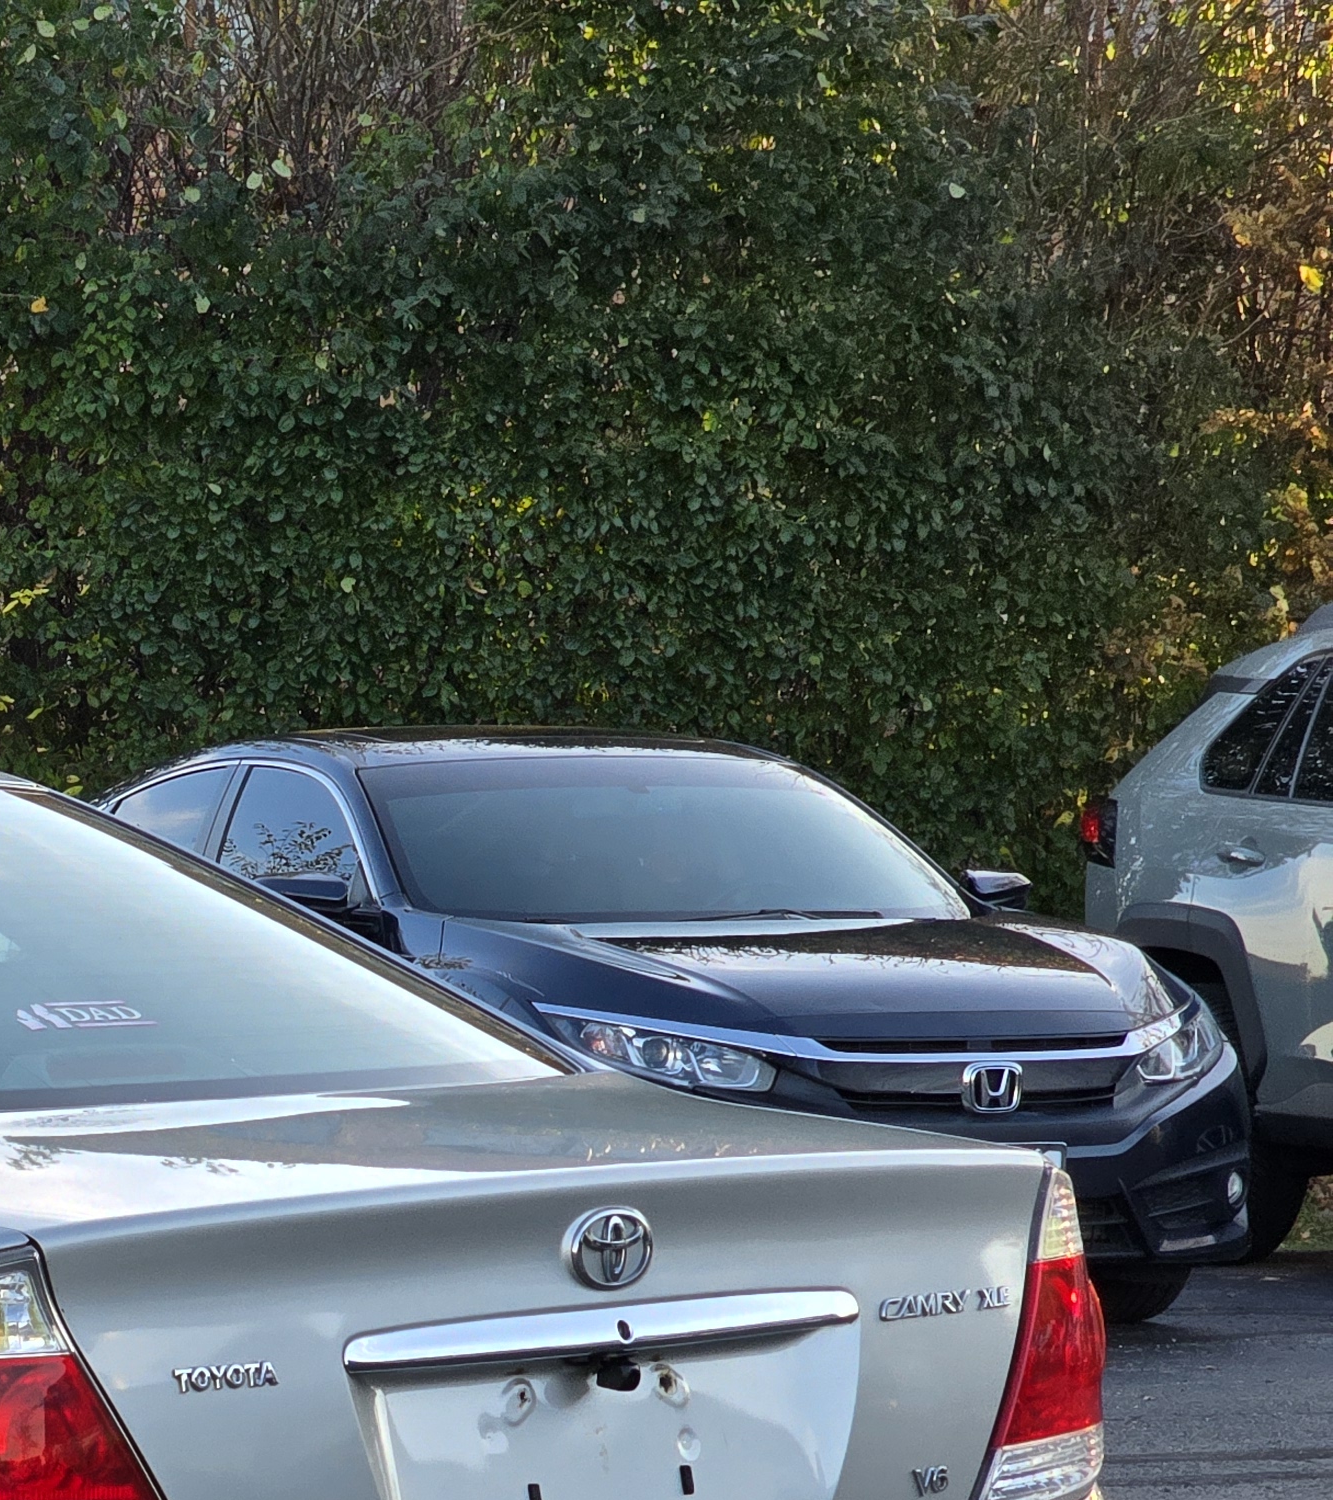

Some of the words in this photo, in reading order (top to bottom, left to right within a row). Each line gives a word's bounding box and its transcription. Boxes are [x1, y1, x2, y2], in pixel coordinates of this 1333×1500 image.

[53, 1005, 142, 1022] DAD
[879, 1289, 971, 1321] CAMRY
[978, 1286, 1012, 1311] XLE
[173, 1361, 279, 1394] TOYOTA
[912, 1465, 949, 1498] V6
